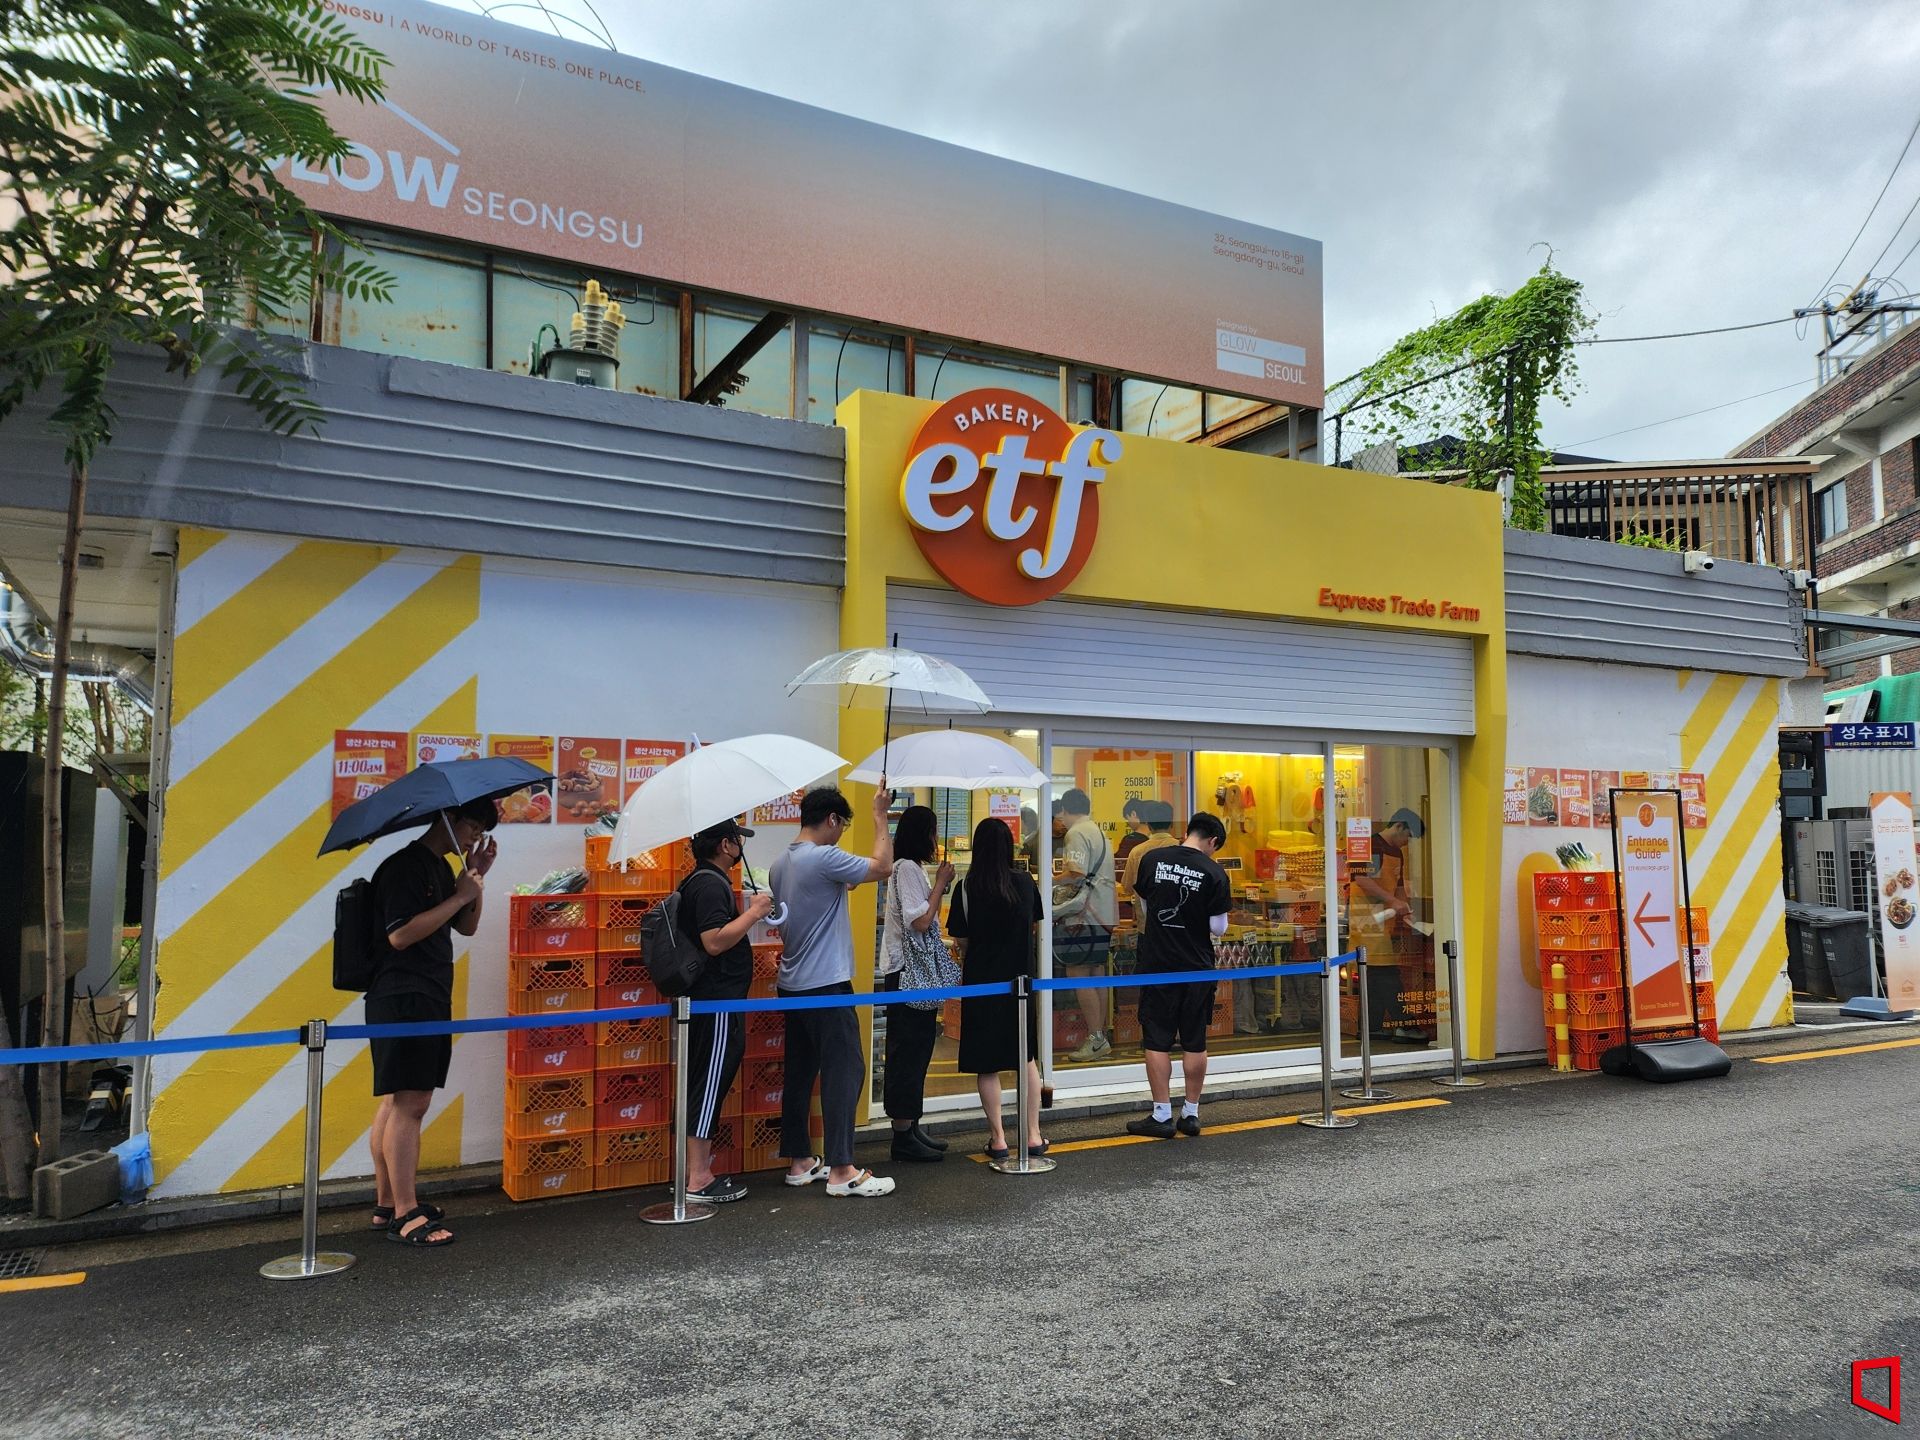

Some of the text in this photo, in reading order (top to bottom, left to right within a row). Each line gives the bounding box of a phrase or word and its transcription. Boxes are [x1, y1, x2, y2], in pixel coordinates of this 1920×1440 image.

[401, 20, 410, 31] A
[416, 23, 473, 47] WORLD
[478, 39, 497, 53] OF
[504, 46, 560, 71] TASTES.
[565, 62, 594, 79] ONE
[600, 71, 646, 94] PLACE.
[250, 138, 643, 249] LOW SEONGSU
[1281, 262, 1304, 276] Seoul
[1219, 333, 1257, 352] GLOW
[1266, 362, 1306, 384] SEOUL
[954, 403, 1045, 432] BAKERY
[900, 428, 1124, 579] etf
[1318, 587, 1480, 622] Express Trade Farm
[1840, 724, 1909, 740] 성수표지
[419, 735, 481, 747] GRAND OPENING
[1093, 776, 1153, 788] ETF 250830
[1627, 835, 1668, 847] Entrance
[1635, 847, 1661, 859] Guide
[1157, 861, 1205, 879] New Balance
[1155, 870, 1202, 888] Hiking Gear
[546, 931, 570, 948] etf
[545, 992, 568, 1007] etf
[622, 987, 643, 1002] etf
[544, 1050, 567, 1066] etf
[623, 1044, 645, 1060] etf
[544, 1112, 567, 1127] etf
[620, 1104, 642, 1119] etf
[544, 1174, 567, 1189] etf
[712, 1193, 738, 1202] crocs
